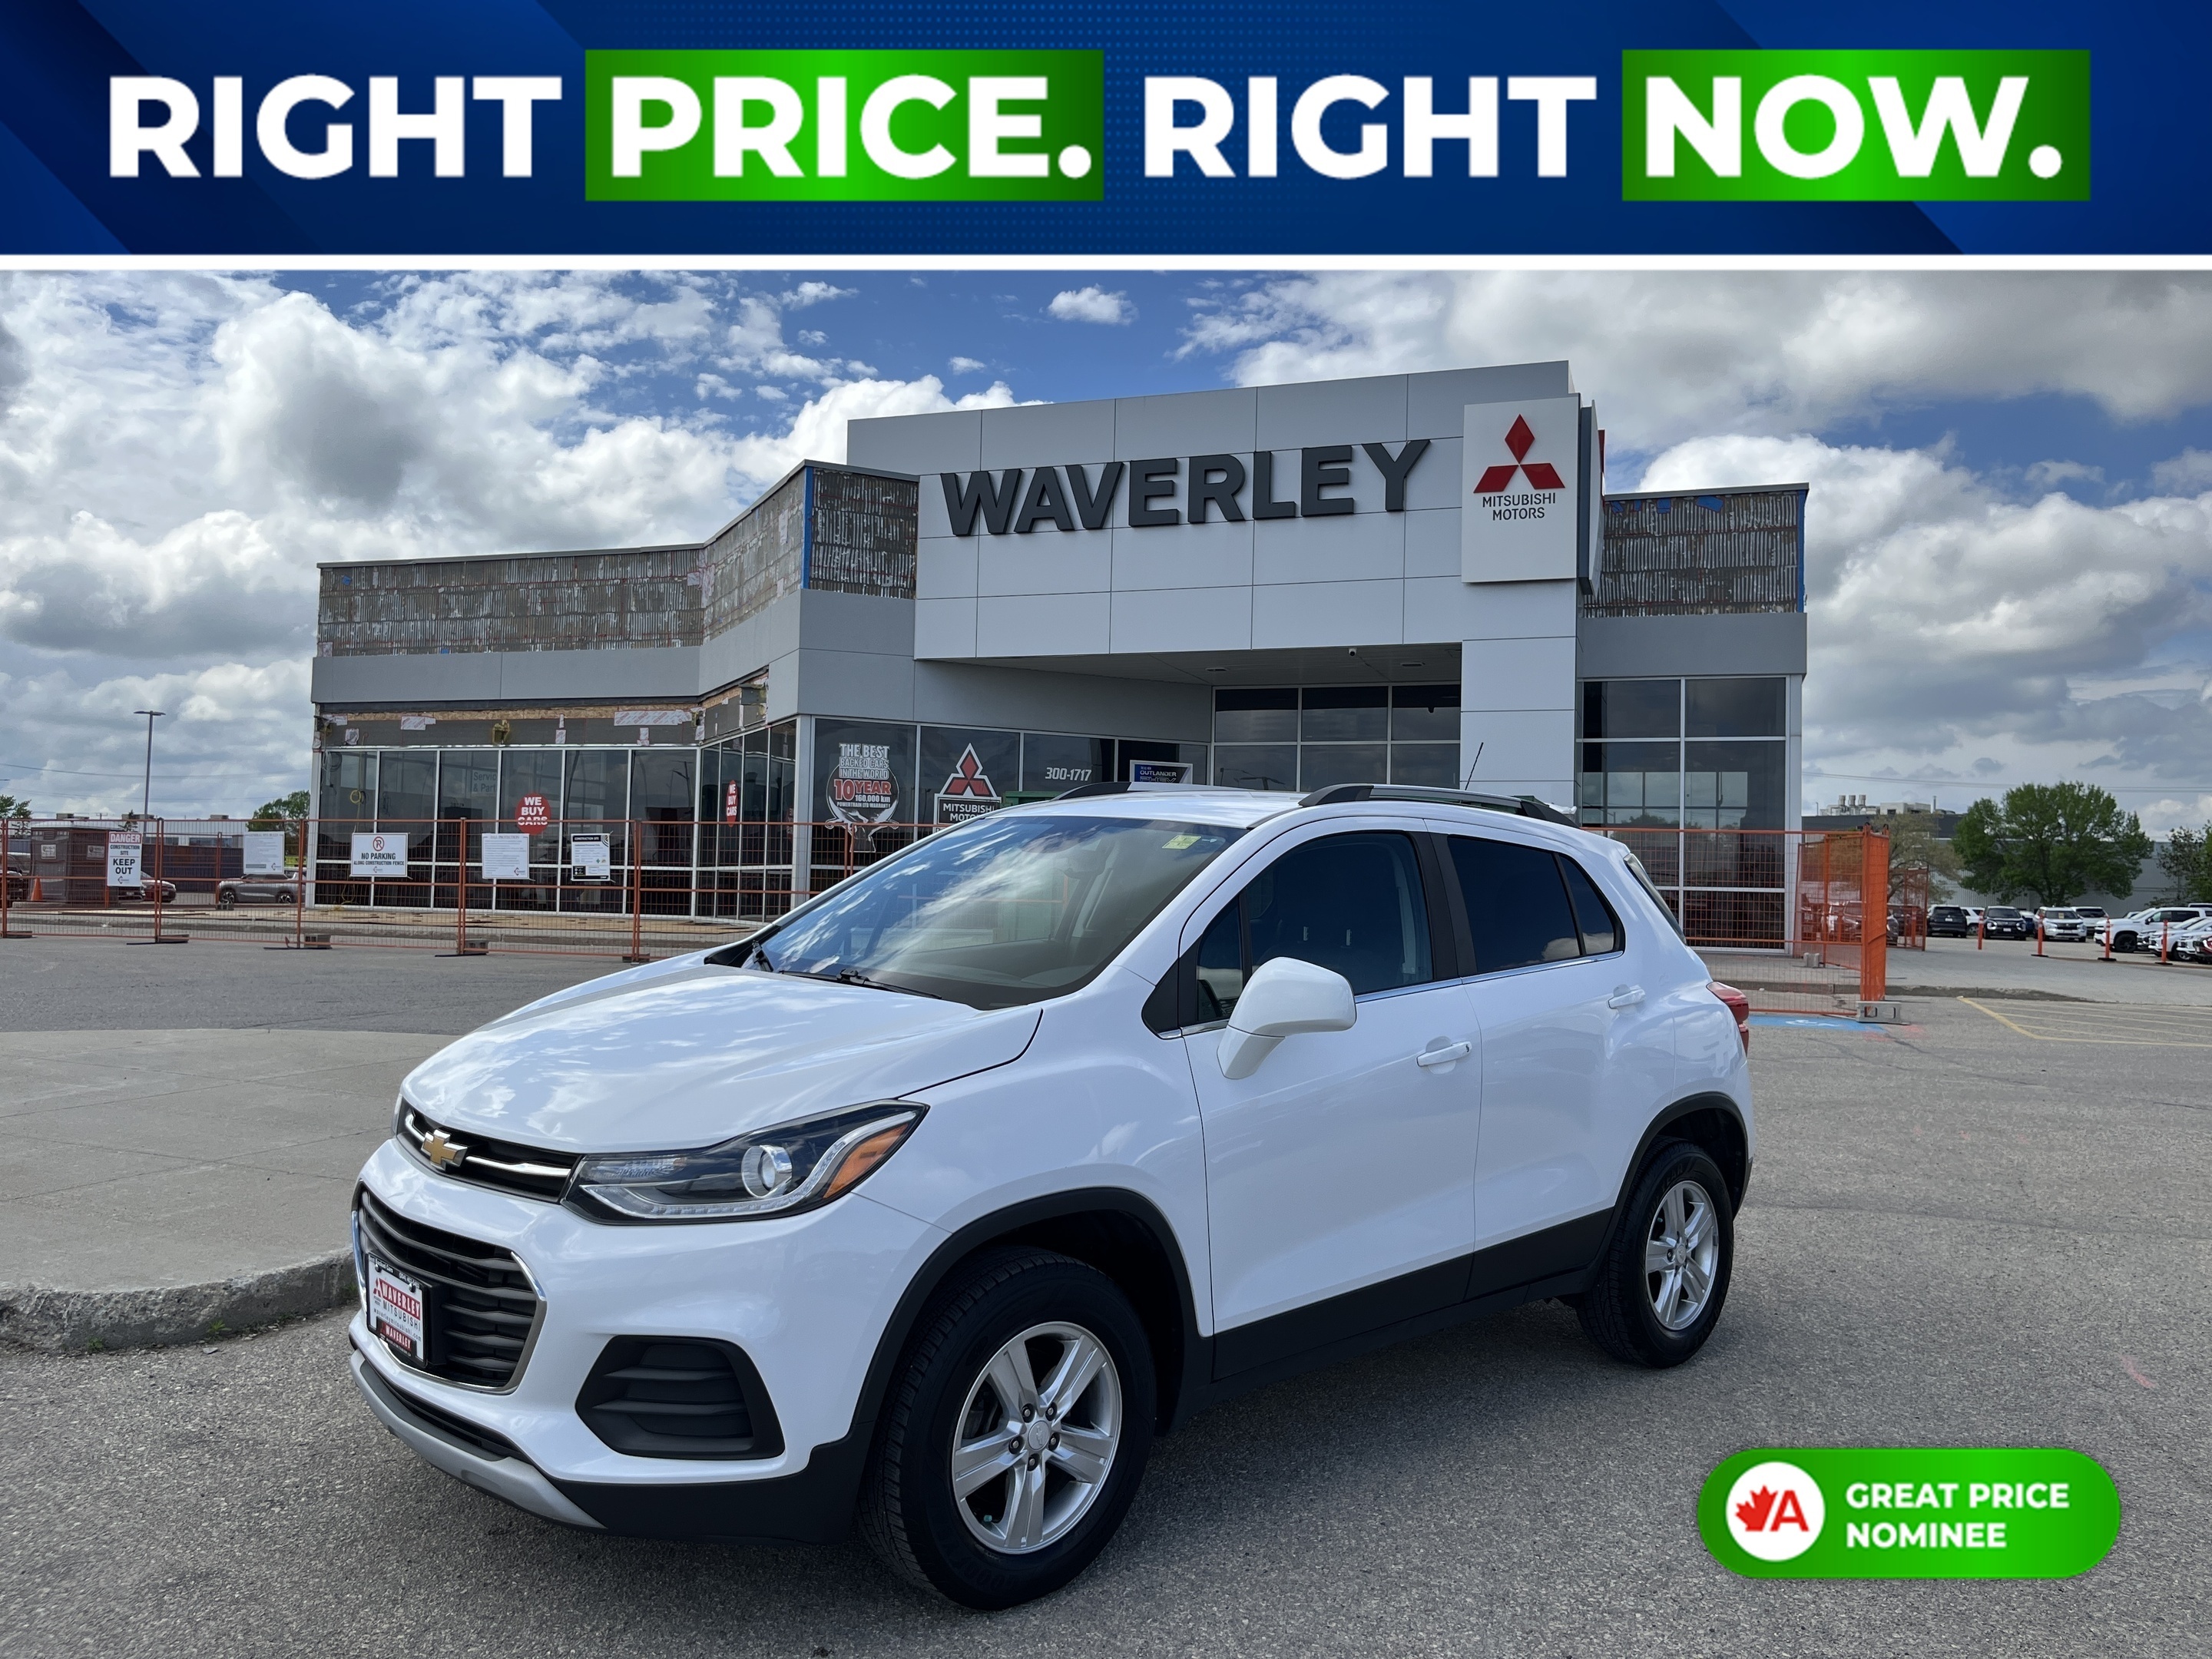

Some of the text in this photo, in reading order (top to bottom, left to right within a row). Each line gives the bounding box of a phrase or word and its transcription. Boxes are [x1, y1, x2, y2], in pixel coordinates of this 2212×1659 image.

[939, 439, 1431, 537] WAVERLEY
[1482, 492, 1555, 508] MITSUBISHI
[1492, 507, 1545, 521] MOTORS
[839, 743, 889, 759] THE BEST
[840, 758, 889, 768] BACKED CARS
[474, 772, 497, 781] Servic
[839, 768, 889, 779] IN THE WORLD
[1045, 767, 1091, 782] 300-1717
[481, 783, 496, 793] Part
[834, 779, 892, 801] 10 YEAR
[525, 796, 541, 806] WE
[728, 795, 737, 806] BUY
[522, 806, 545, 816] BUY
[727, 806, 737, 816] CARS
[943, 803, 995, 813] MITSUBISHI
[518, 816, 548, 826] CARS
[110, 833, 141, 843] DANGER
[113, 858, 135, 866] KEEP
[381, 1281, 420, 1317] WAVERLEY
[382, 1300, 421, 1332] MITSUBISHI
[385, 1323, 412, 1349] WAVERLEY
